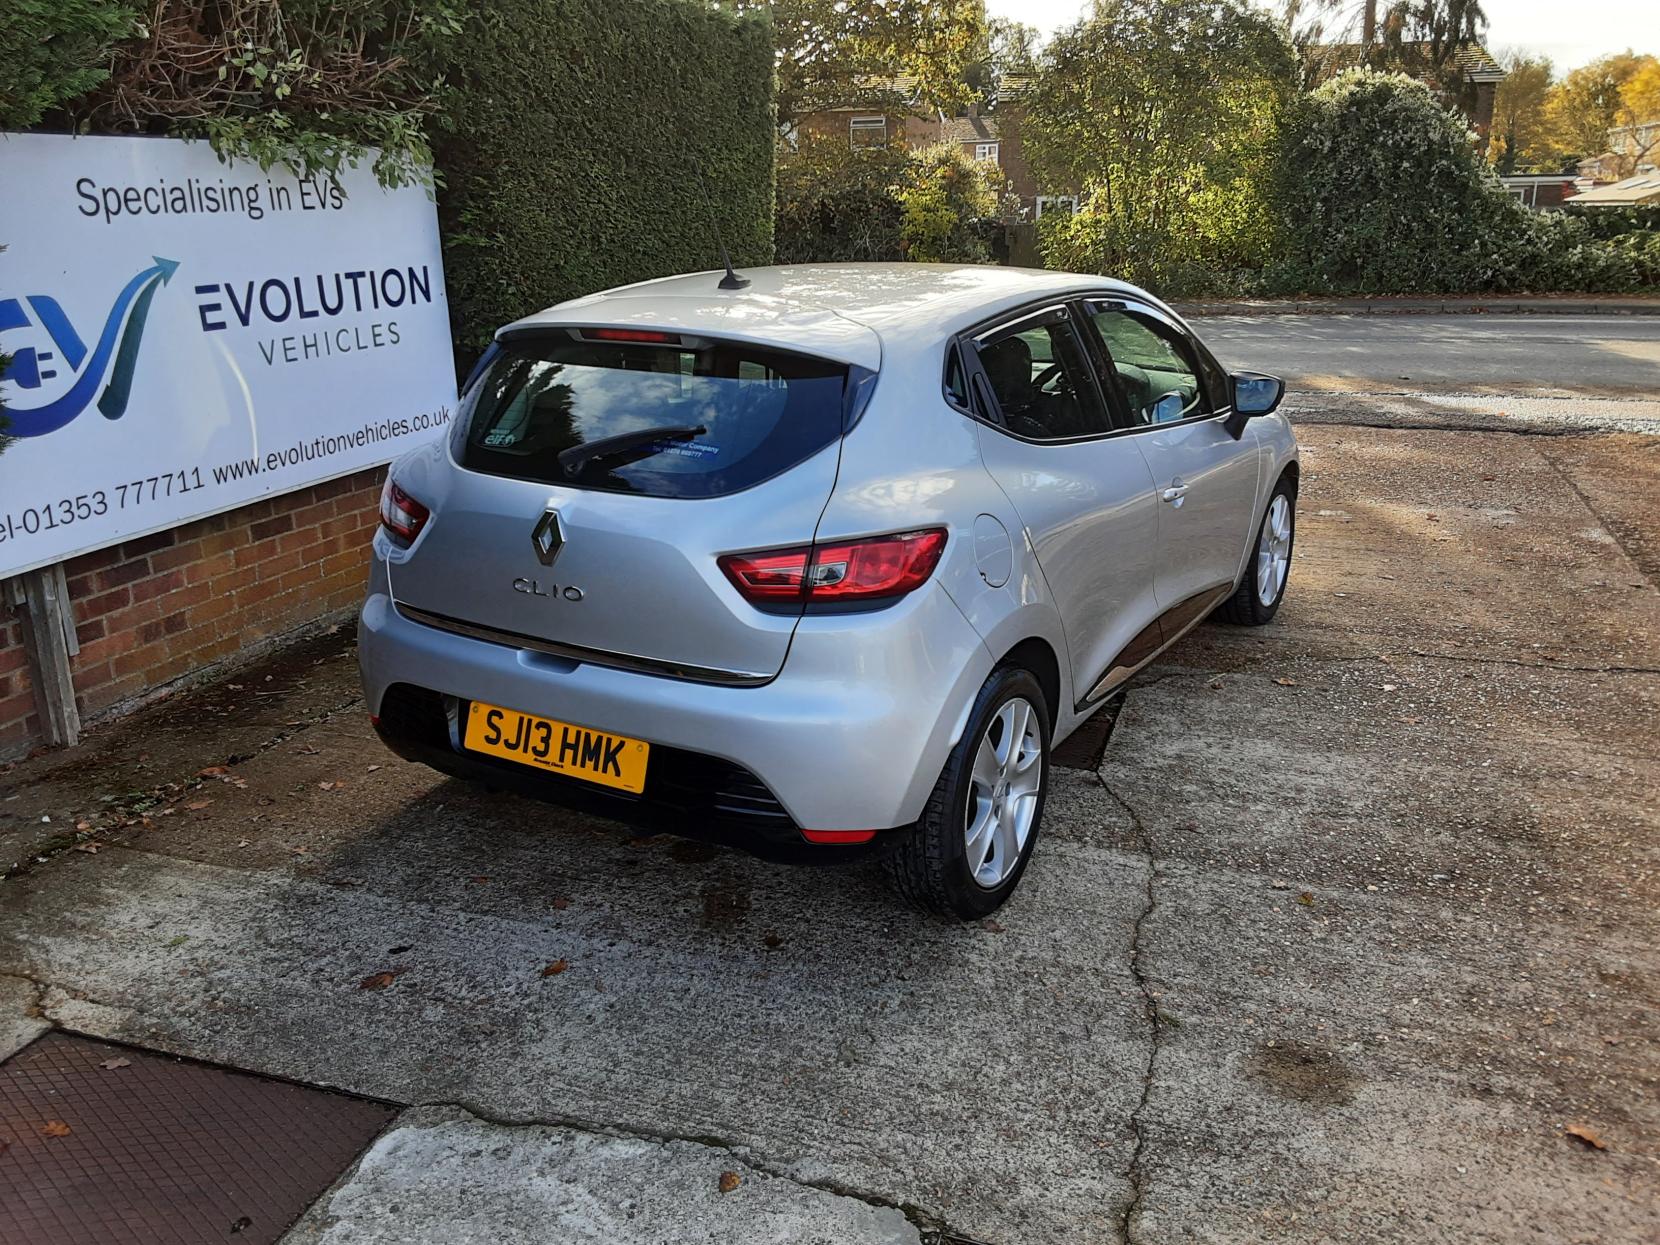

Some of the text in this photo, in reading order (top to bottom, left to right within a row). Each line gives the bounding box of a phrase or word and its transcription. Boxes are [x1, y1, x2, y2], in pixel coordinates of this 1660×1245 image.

[76, 177, 344, 224] Specialising in EVs
[194, 265, 432, 332] EVOLUTION
[258, 321, 401, 366] VEHICLES
[115, 466, 205, 509] 777711
[212, 405, 450, 485] www.evolutionvehicles.co.uk
[513, 577, 585, 602] CLIO
[484, 708, 626, 778] SJ13 HMK
